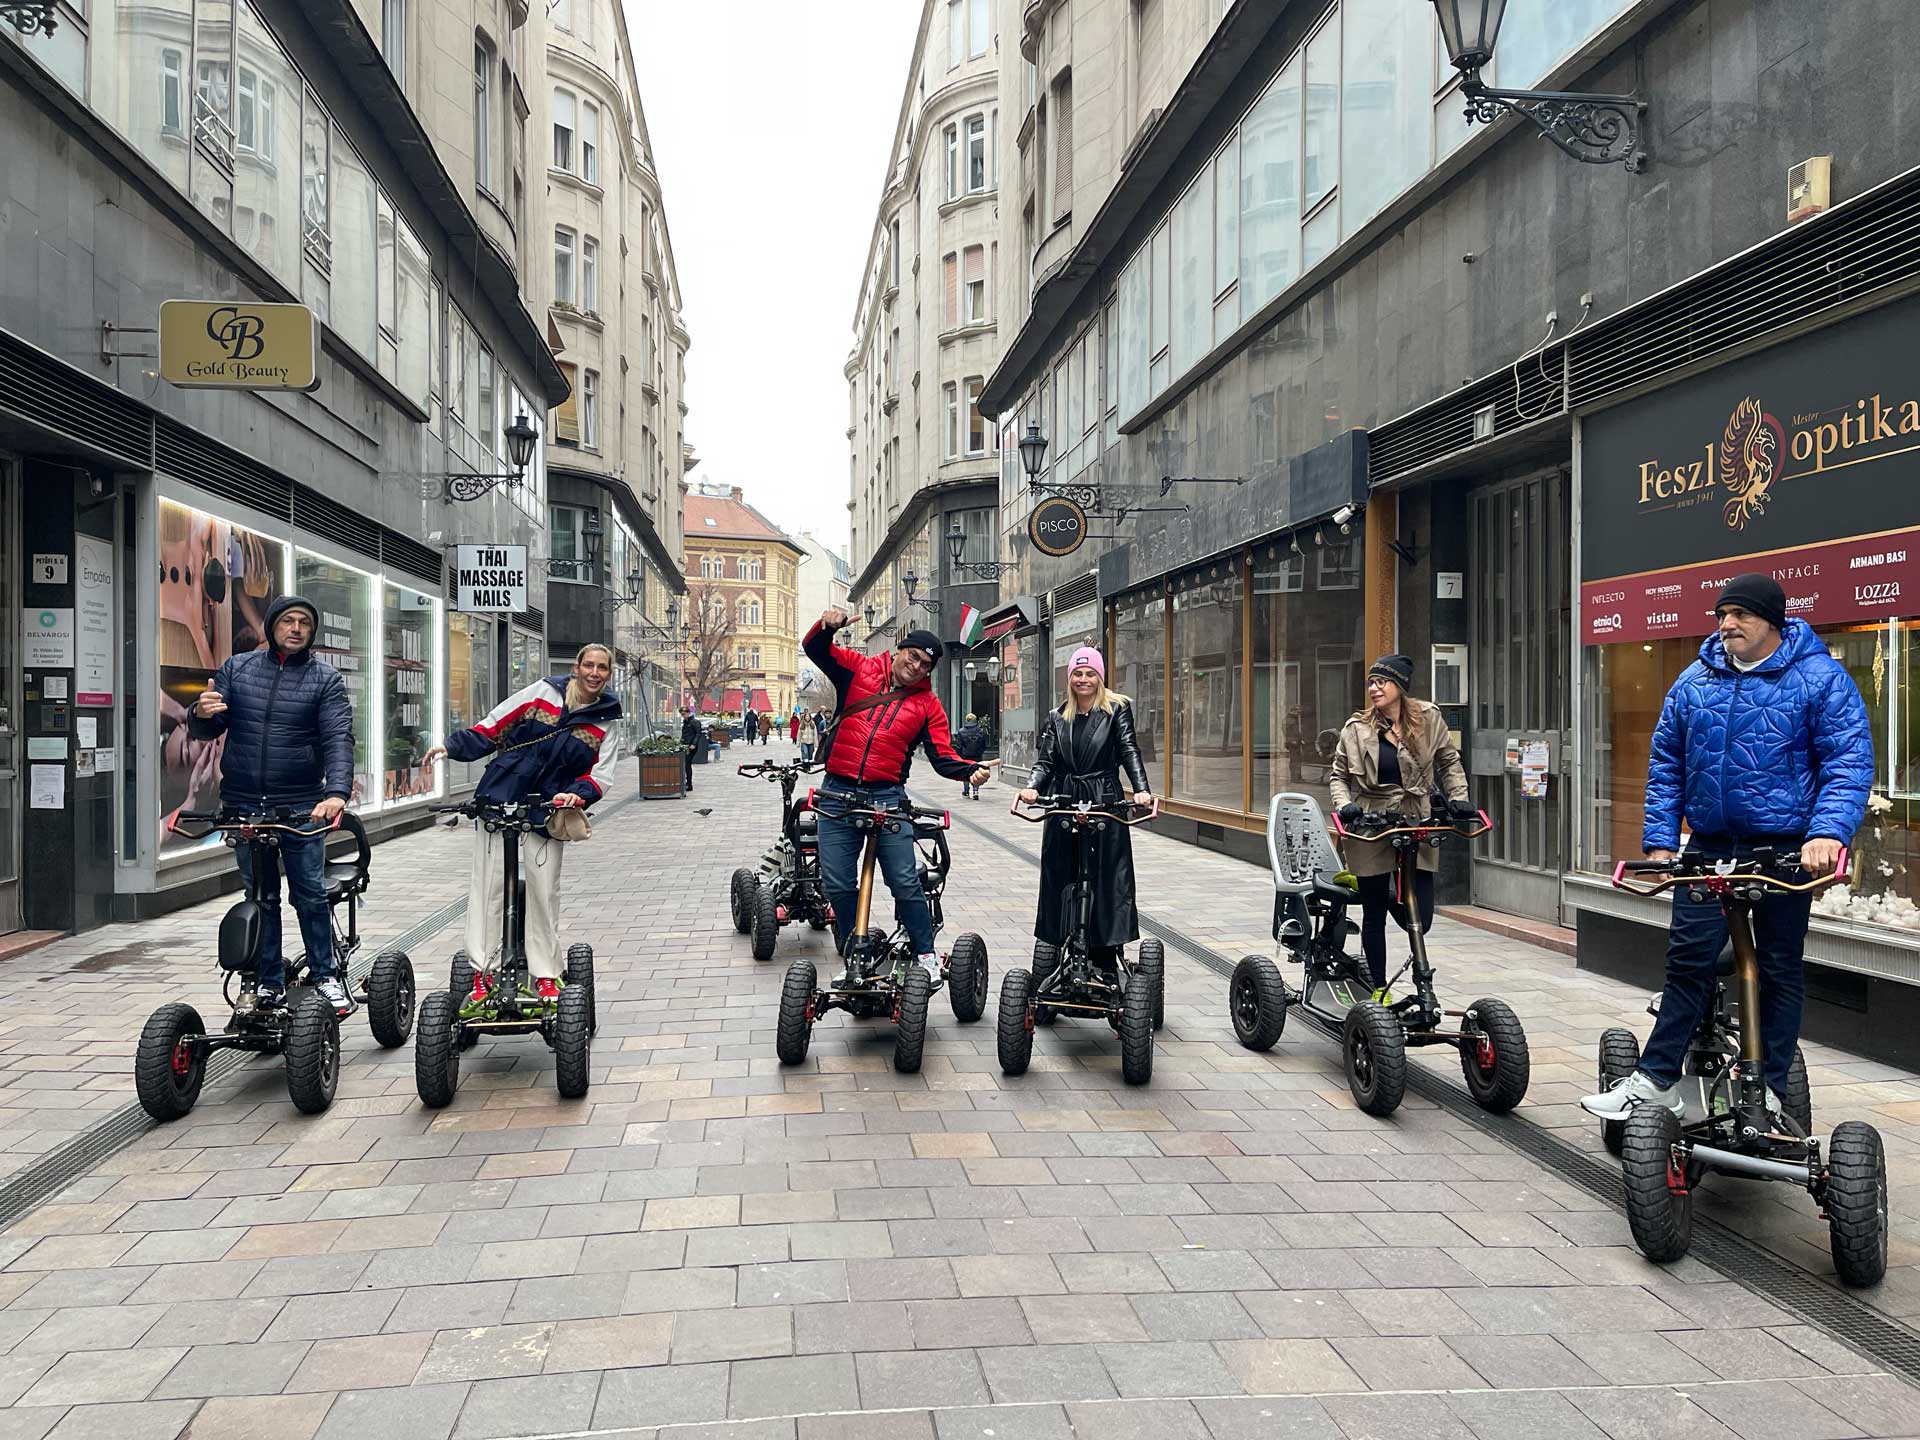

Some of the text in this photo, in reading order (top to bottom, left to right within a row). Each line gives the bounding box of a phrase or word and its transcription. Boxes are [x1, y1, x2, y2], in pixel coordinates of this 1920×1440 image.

[186, 361, 289, 382] Gold Beauty
[1638, 393, 1920, 504] Feszl optika
[1039, 518, 1078, 533] PISCO
[476, 550, 508, 567] THAI
[1849, 550, 1906, 569] ARMAND BASI
[45, 565, 55, 580] 9
[83, 567, 111, 585] Empátia
[460, 570, 524, 587] MASSAGE
[1772, 564, 1820, 580] INFACE
[1446, 582, 1454, 596] 7
[473, 590, 511, 607] NAILS
[1647, 612, 1679, 625] vistan
[402, 629, 421, 663] THAI
[397, 669, 426, 694] MASSAGE
[402, 703, 420, 727] NAILS
